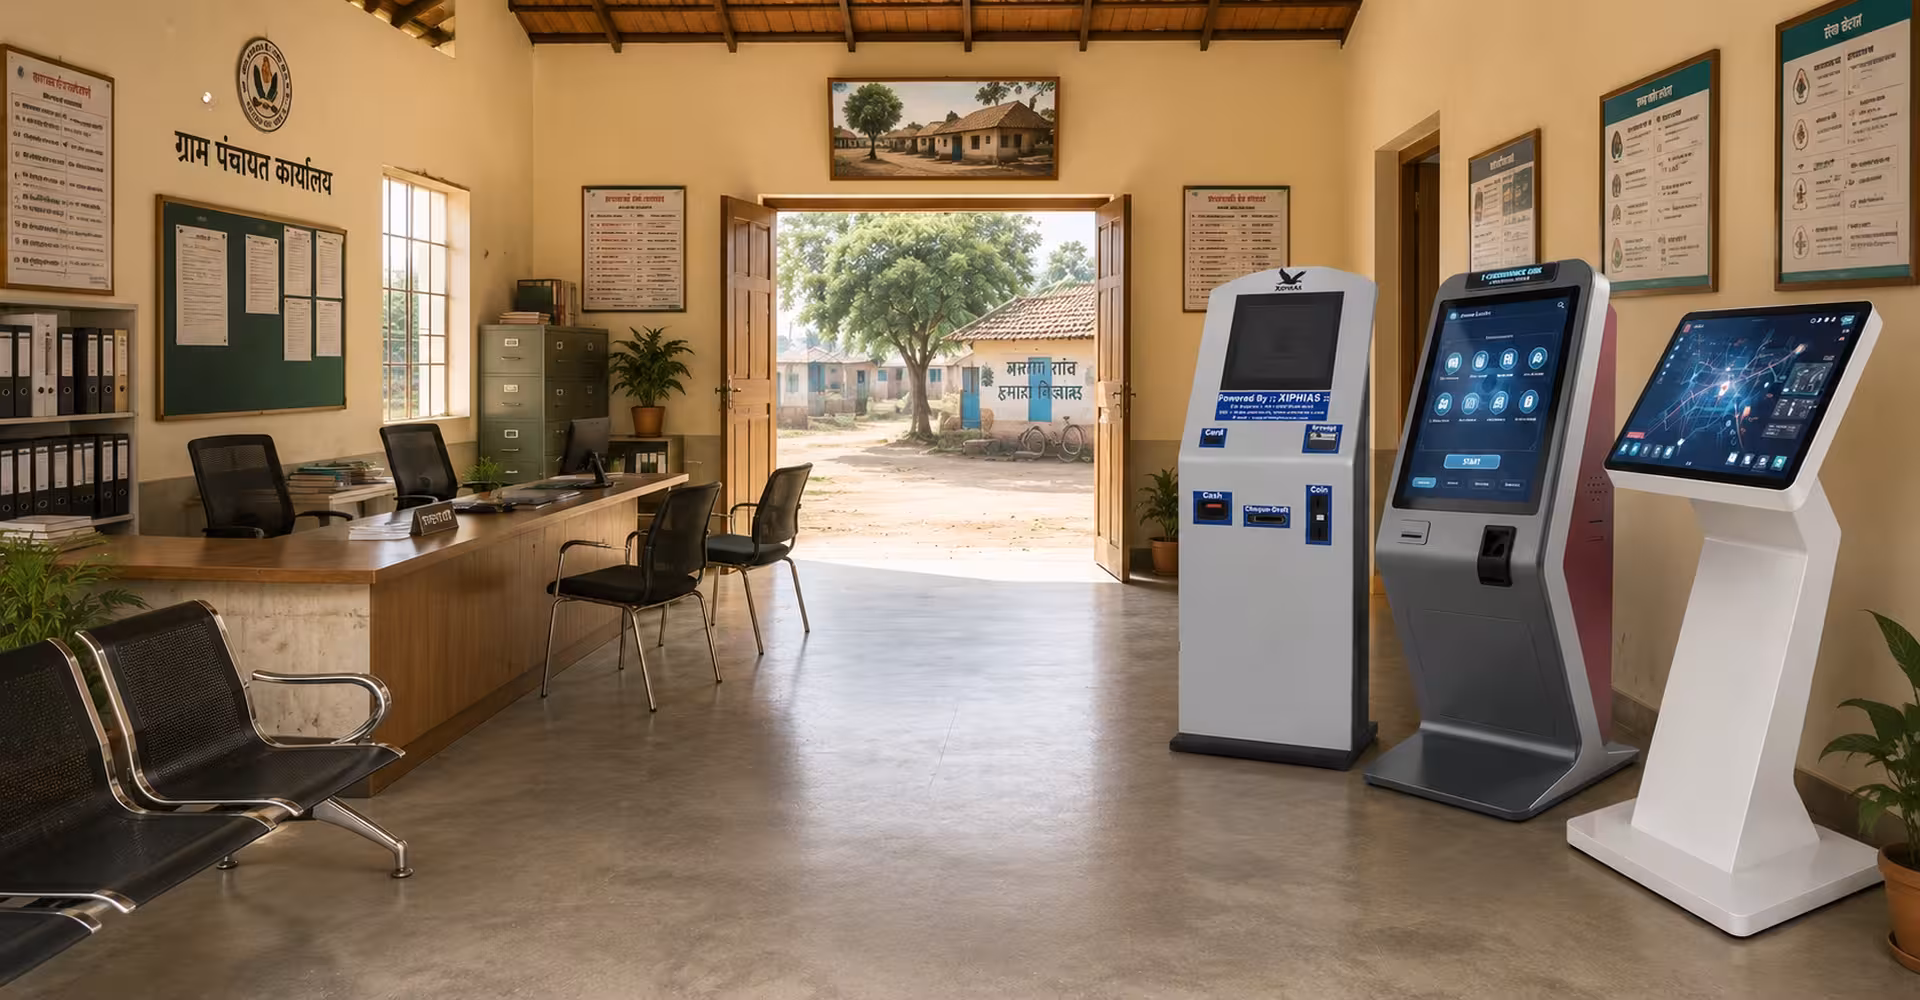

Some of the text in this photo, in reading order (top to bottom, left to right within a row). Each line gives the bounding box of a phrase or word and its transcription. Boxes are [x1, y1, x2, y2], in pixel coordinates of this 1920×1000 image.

[175, 131, 333, 195] ग्राम पंचायत कार्यालय
[1218, 393, 1255, 403] Powered
[1256, 394, 1267, 404] By
[1278, 393, 1322, 403] XIPHIAS
[1310, 485, 1329, 494] Coin
